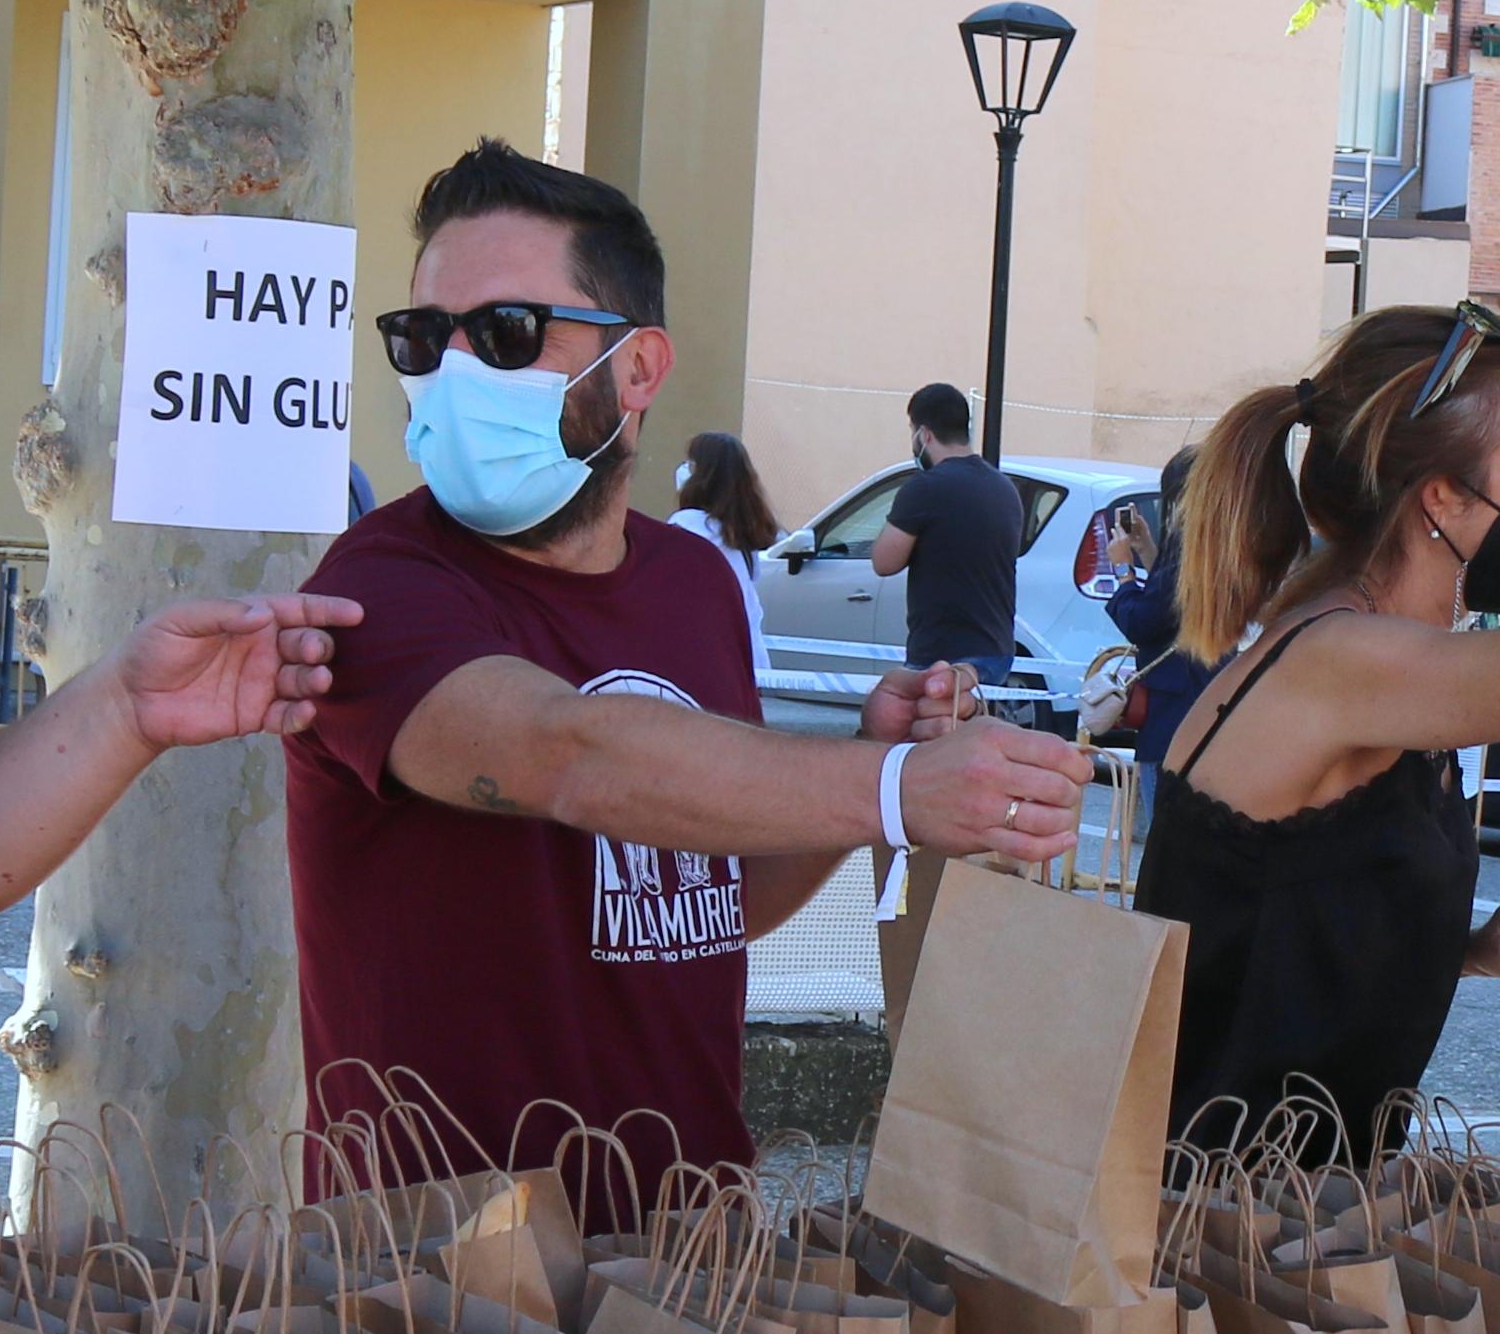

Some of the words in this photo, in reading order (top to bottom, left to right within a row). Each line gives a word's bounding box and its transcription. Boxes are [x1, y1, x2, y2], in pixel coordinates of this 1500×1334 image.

[205, 270, 316, 326] HAY
[330, 279, 354, 331] P
[150, 370, 252, 425] SIN
[591, 948, 631, 963] CUNA
[634, 949, 656, 962] DEL
[682, 948, 697, 960] EN
